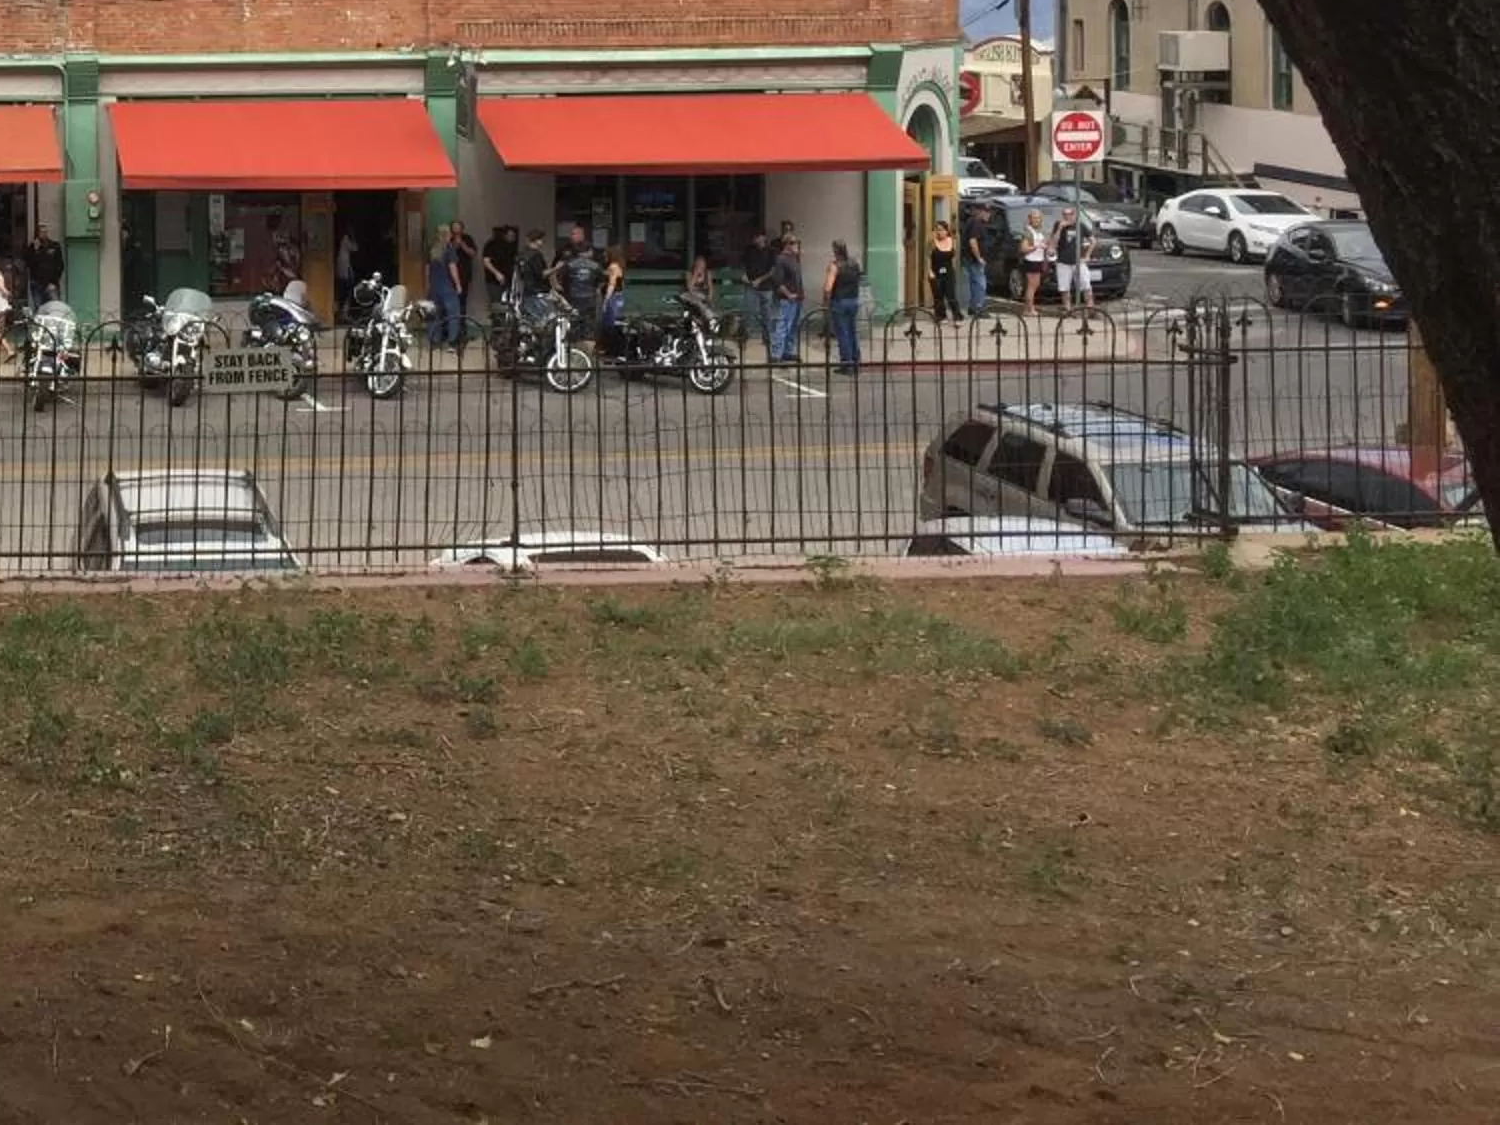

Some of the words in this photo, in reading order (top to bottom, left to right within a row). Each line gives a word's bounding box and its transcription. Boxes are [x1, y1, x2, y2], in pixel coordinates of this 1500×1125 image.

[1077, 120, 1096, 131] NOT
[1063, 142, 1093, 153] ENTER
[214, 354, 243, 368] STAY
[247, 352, 281, 367] BACK
[208, 370, 245, 385] FROM
[248, 368, 289, 383] FENCE
